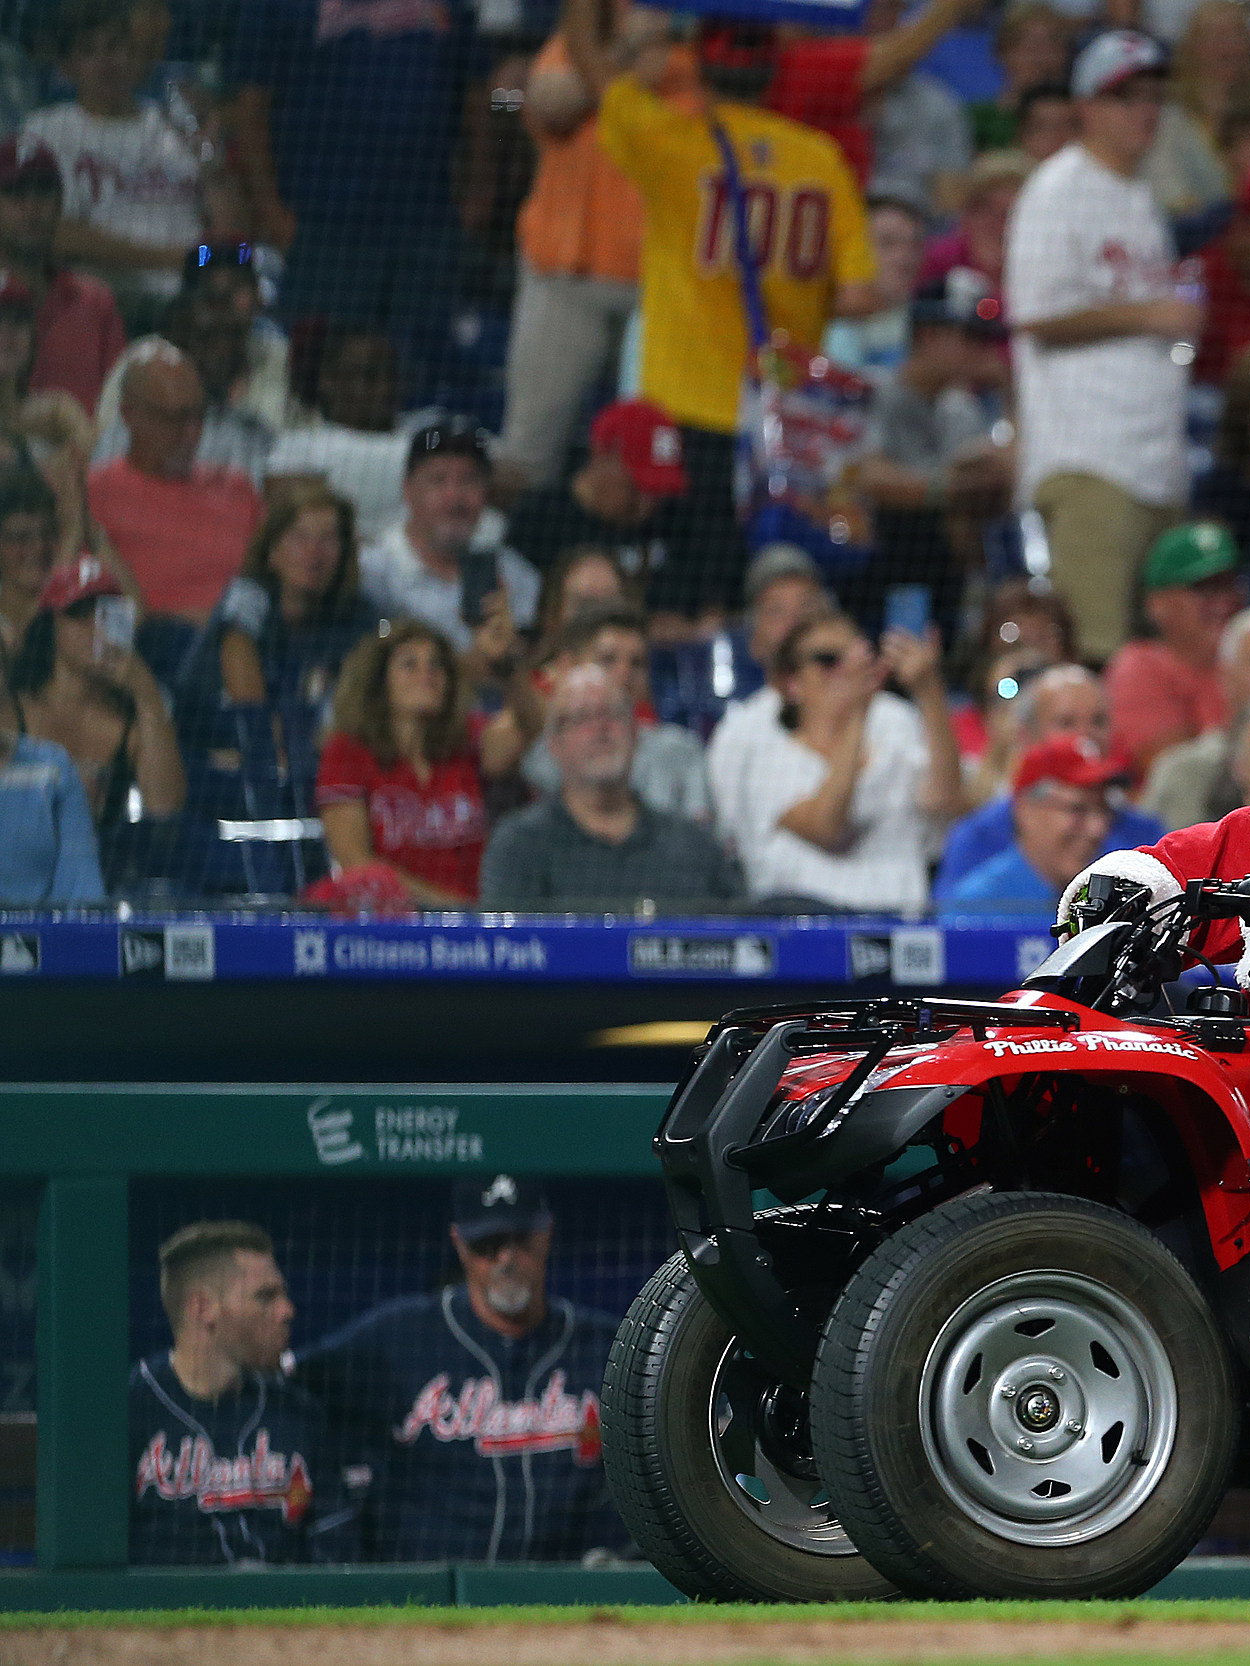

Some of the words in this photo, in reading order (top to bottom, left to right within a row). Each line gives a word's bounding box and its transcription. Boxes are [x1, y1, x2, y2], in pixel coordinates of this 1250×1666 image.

[697, 170, 832, 282] 100
[334, 934, 428, 970] Citizens
[431, 934, 490, 971] Bank
[493, 935, 547, 971] Park
[983, 1040, 1077, 1057] Phillie
[1076, 1034, 1199, 1060] Phanatic
[375, 1105, 459, 1134] ENERGY
[377, 1133, 483, 1162] TRANSFER
[394, 1368, 581, 1443] Atlanta
[137, 1428, 287, 1500] Atlanta
